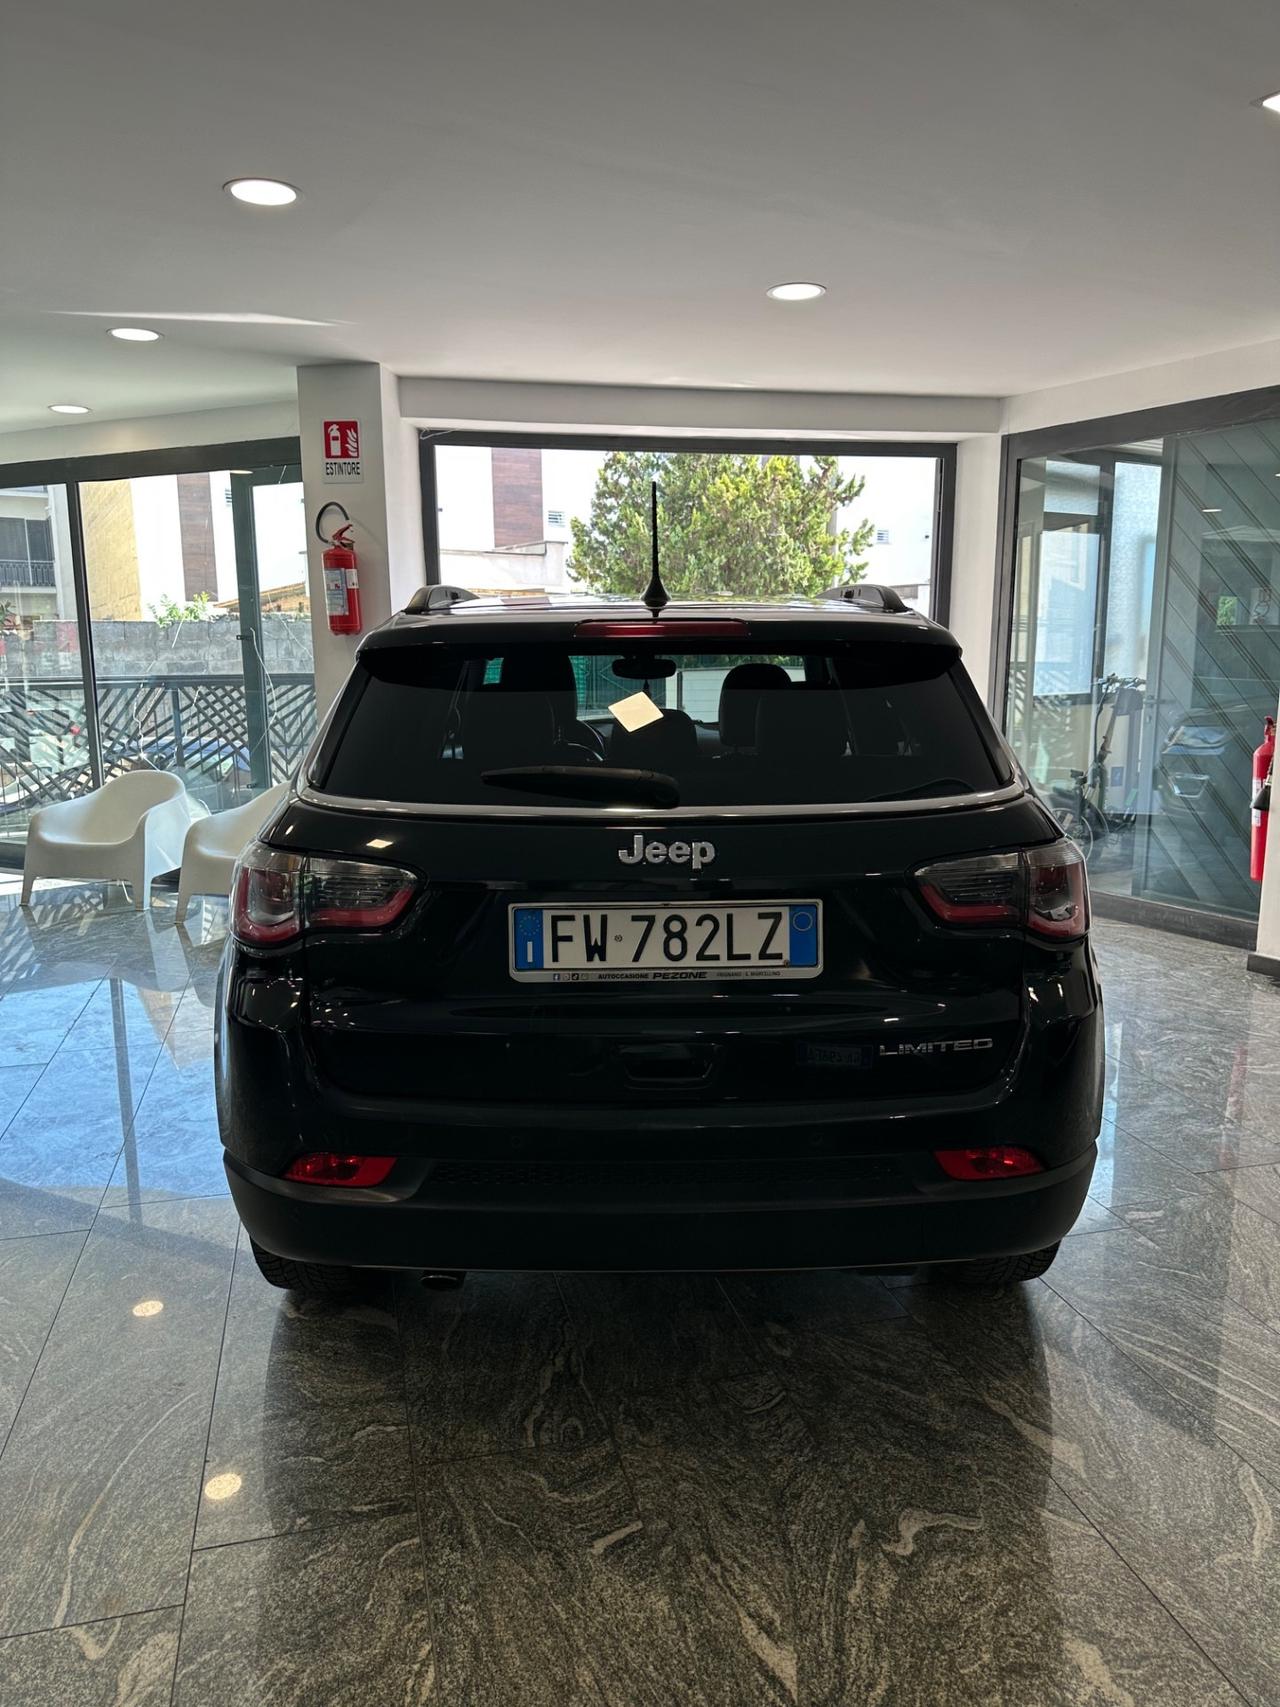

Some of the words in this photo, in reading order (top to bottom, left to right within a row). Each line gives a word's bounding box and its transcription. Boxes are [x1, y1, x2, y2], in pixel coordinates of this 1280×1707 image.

[325, 462, 361, 475] ESTINTORE
[618, 834, 715, 869] Jeep
[551, 914, 608, 962] FW
[631, 912, 783, 962] 782LZ
[652, 971, 708, 980] PEZONE
[879, 1038, 993, 1056] LIMITED
